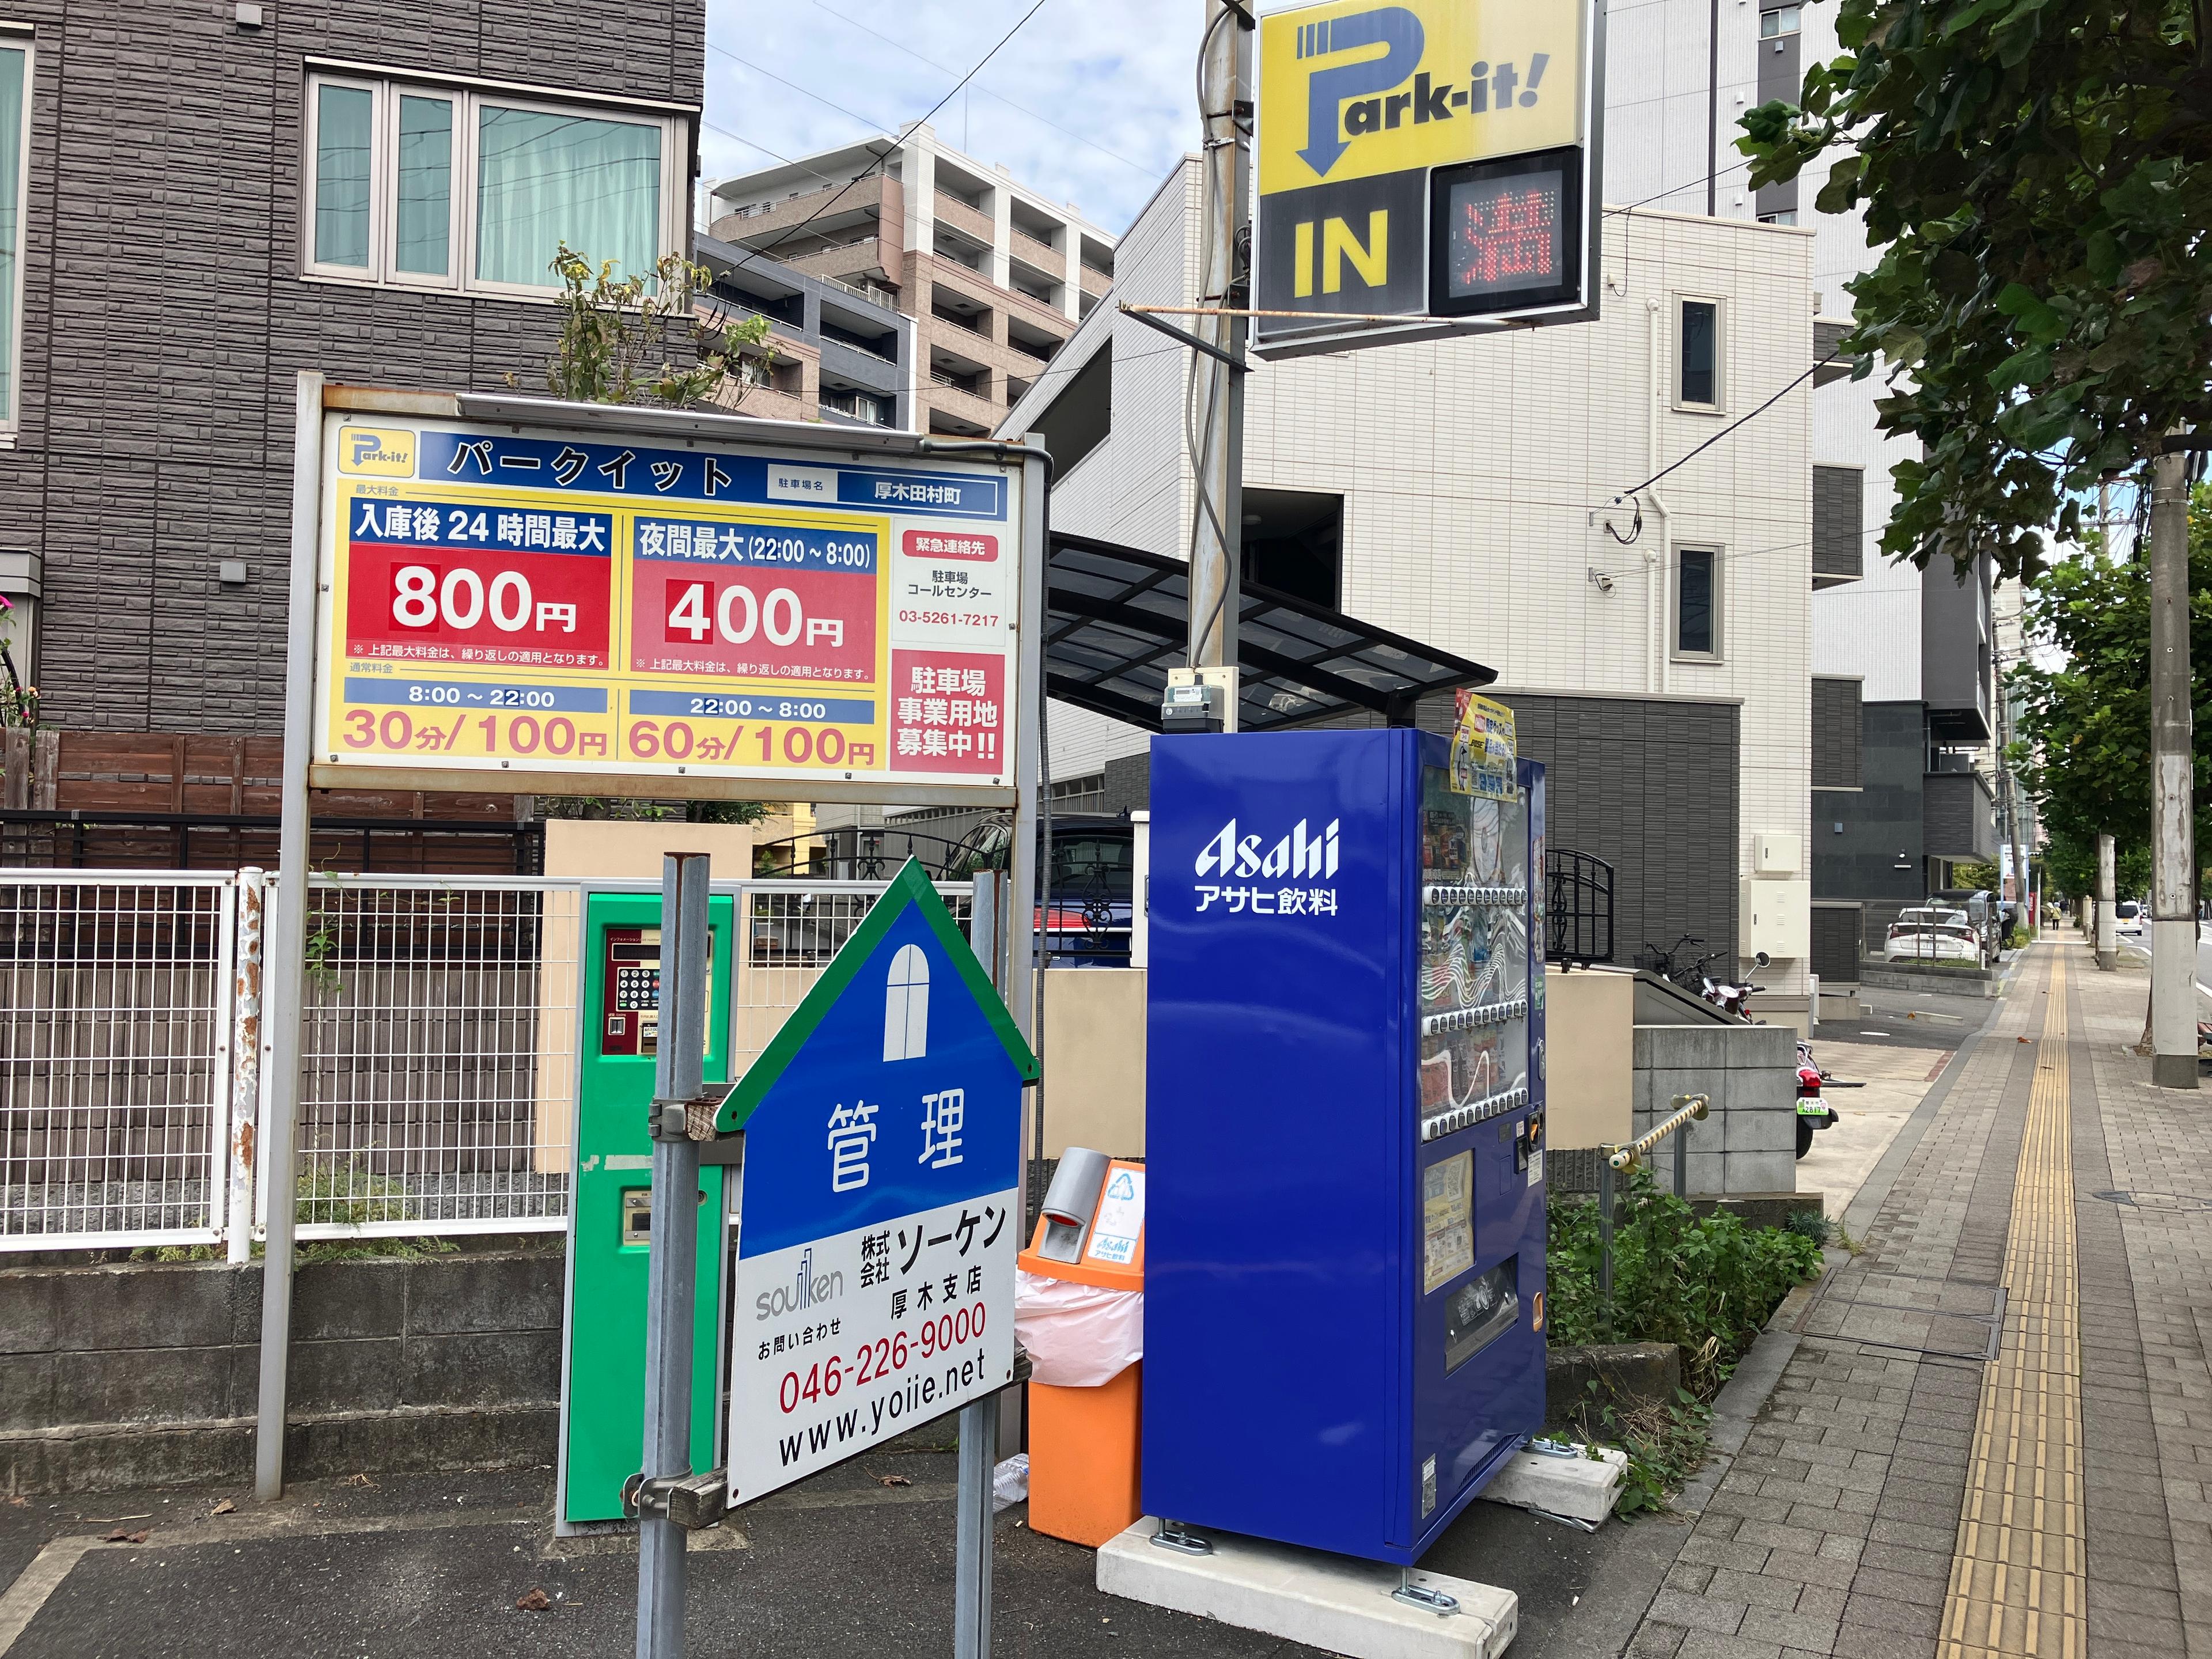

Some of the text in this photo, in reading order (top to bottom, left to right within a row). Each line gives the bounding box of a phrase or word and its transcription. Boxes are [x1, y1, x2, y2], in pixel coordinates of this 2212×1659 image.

[1295, 6, 1550, 177] Park-it!
[1294, 209, 1388, 298] IN
[351, 434, 408, 467] Park-it!
[446, 440, 732, 497] パークイット
[778, 478, 823, 491] 駐車場名
[355, 484, 399, 497] 最大料金
[874, 482, 961, 505] 厚木田村町
[915, 537, 986, 555] 緊急連絡先
[908, 584, 992, 599] コールセンター
[932, 570, 968, 584] 駐車場
[392, 566, 576, 633] 800円
[668, 584, 844, 647] 400円
[899, 610, 999, 627] 03-5261-7217
[350, 662, 393, 674] 通常料金
[911, 666, 986, 696] 駐車場
[897, 697, 998, 728] 事業用地
[1195, 817, 1339, 880] Asahi
[1195, 885, 1338, 916] アサヒ飲料
[827, 1088, 965, 1193] 管理
[899, 1205, 1006, 1275] ソーケン
[1097, 1237, 1129, 1253] Asahi
[891, 1264, 983, 1321] 厚木支店
[757, 1317, 842, 1361] お問い合わせ
[779, 1301, 986, 1414] 046-226-9000
[778, 1347, 986, 1467] www.yoiie.net
